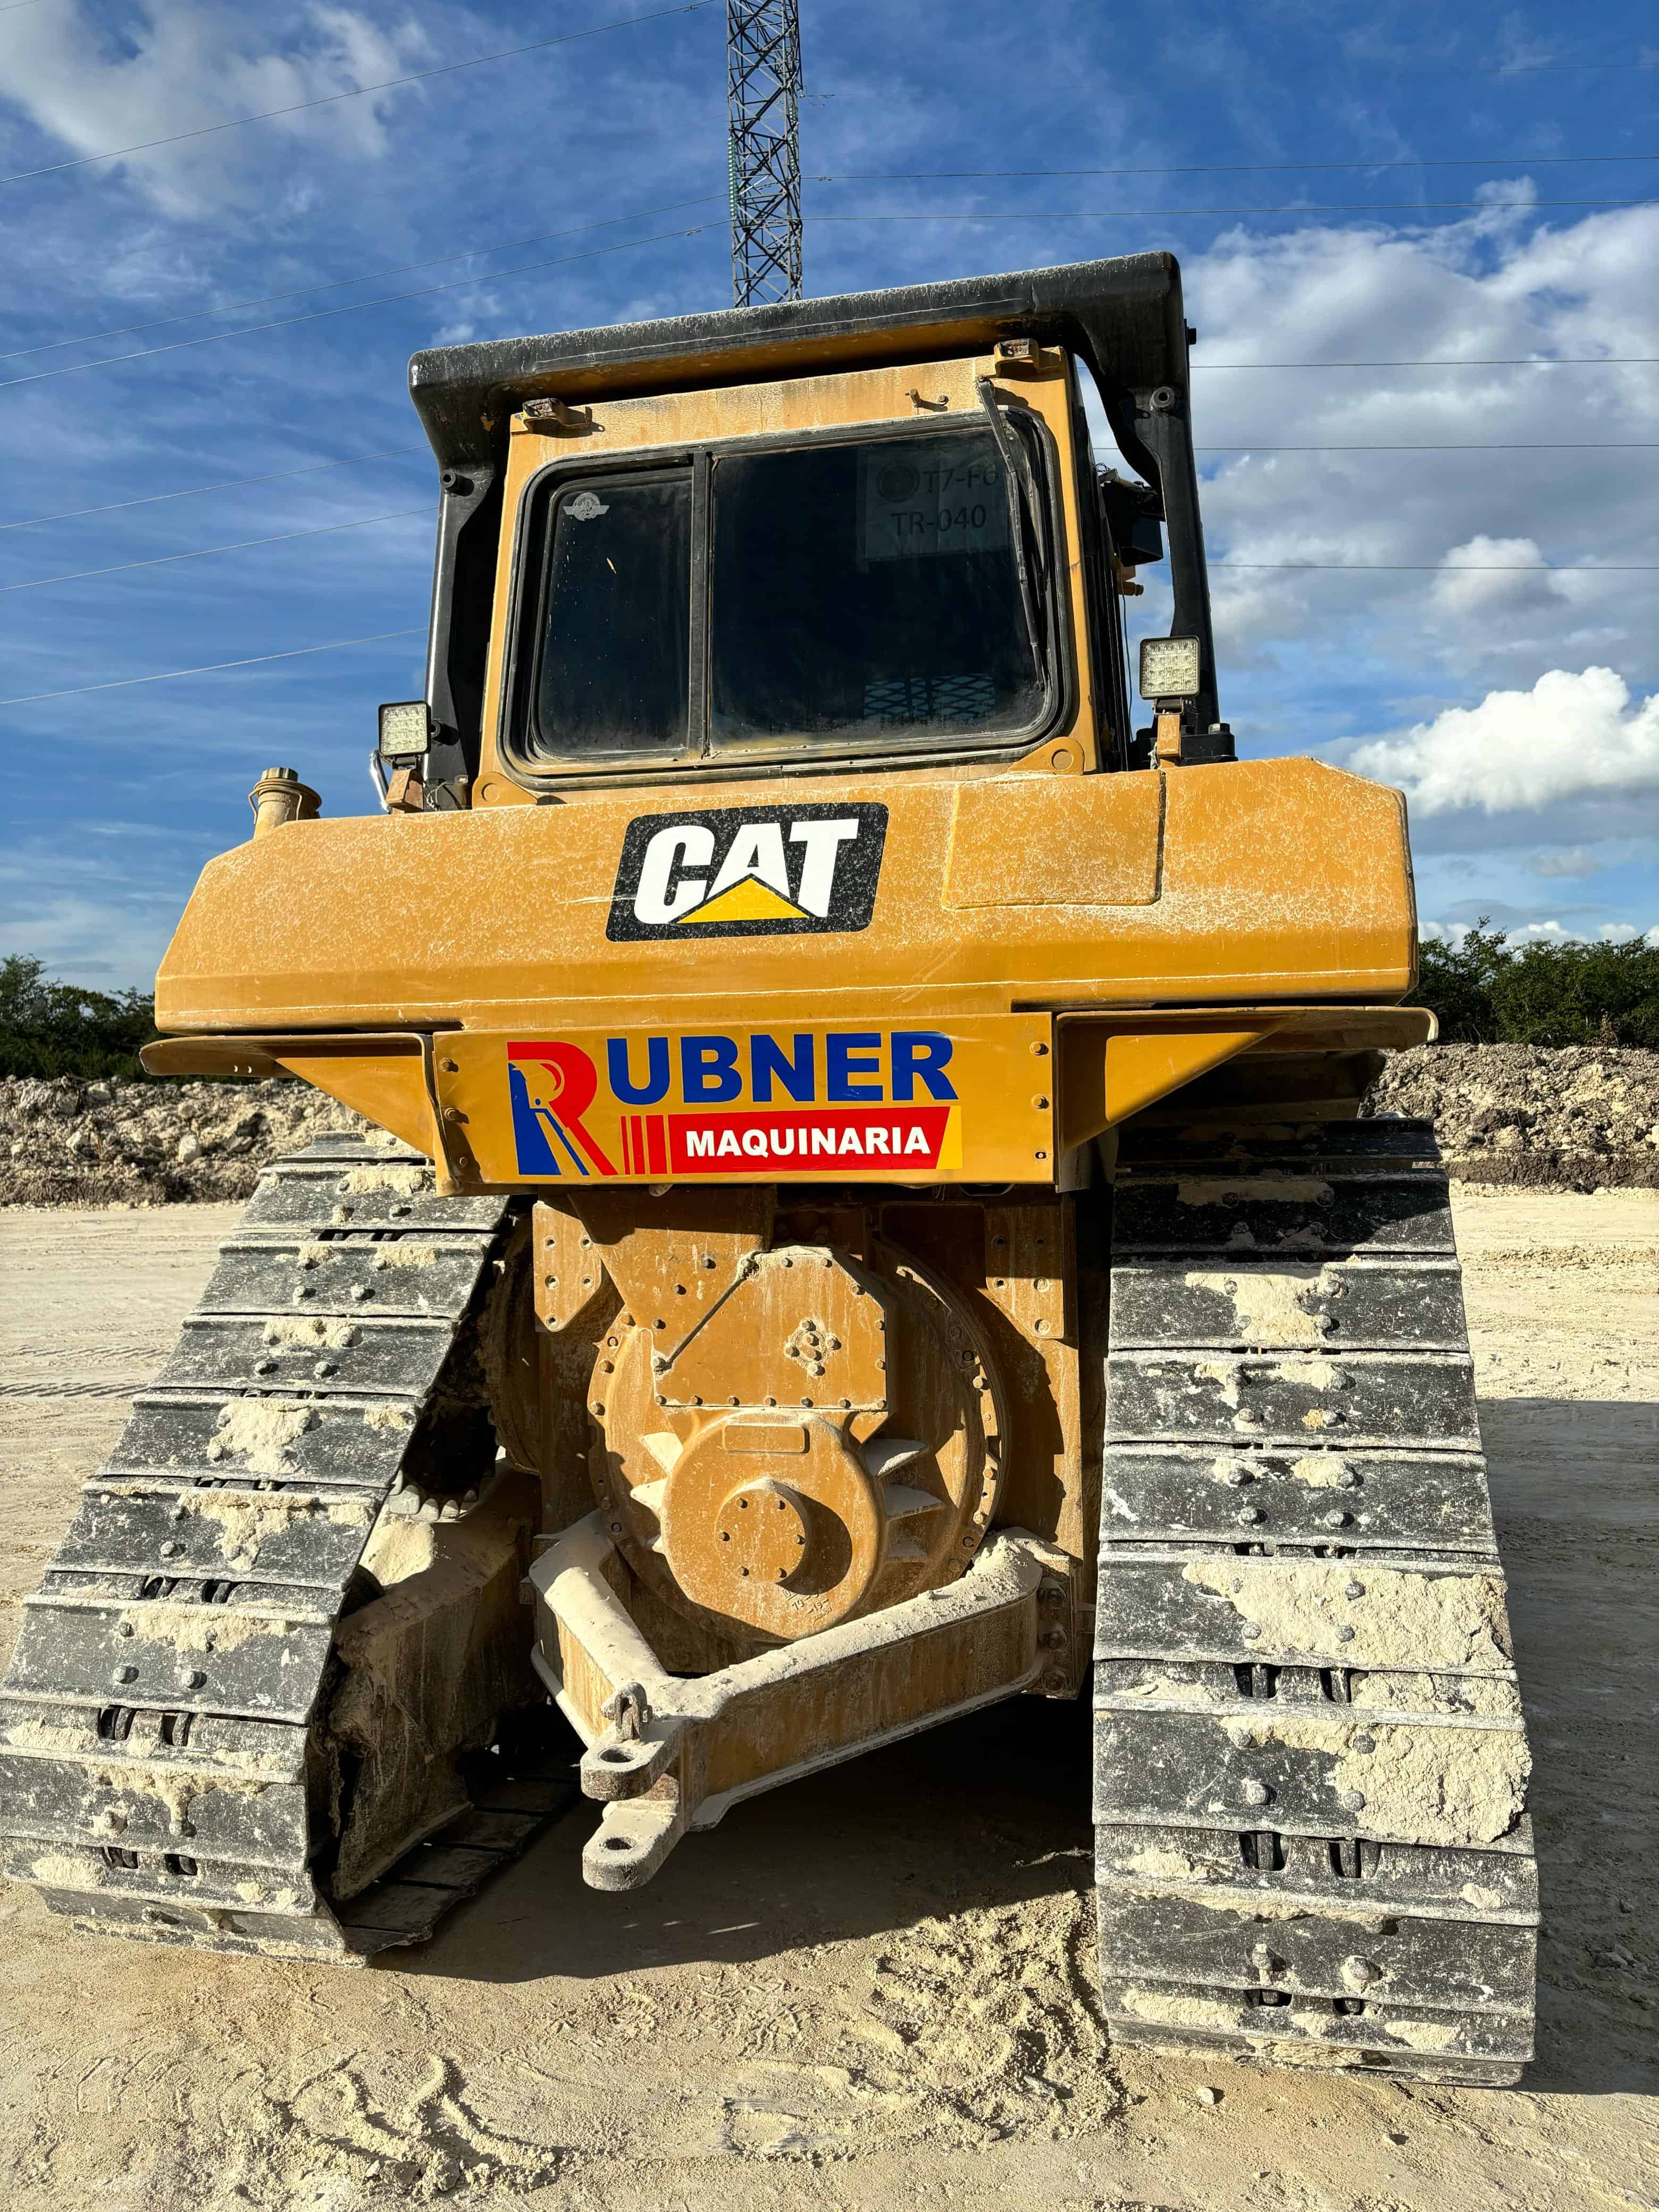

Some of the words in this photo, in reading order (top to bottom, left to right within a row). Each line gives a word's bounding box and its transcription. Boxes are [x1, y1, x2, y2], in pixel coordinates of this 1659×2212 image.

[891, 505, 987, 537] TR-040
[633, 818, 859, 924] CAT
[507, 1031, 959, 1176] RUBNER
[685, 1127, 931, 1158] MAQUINARIA
